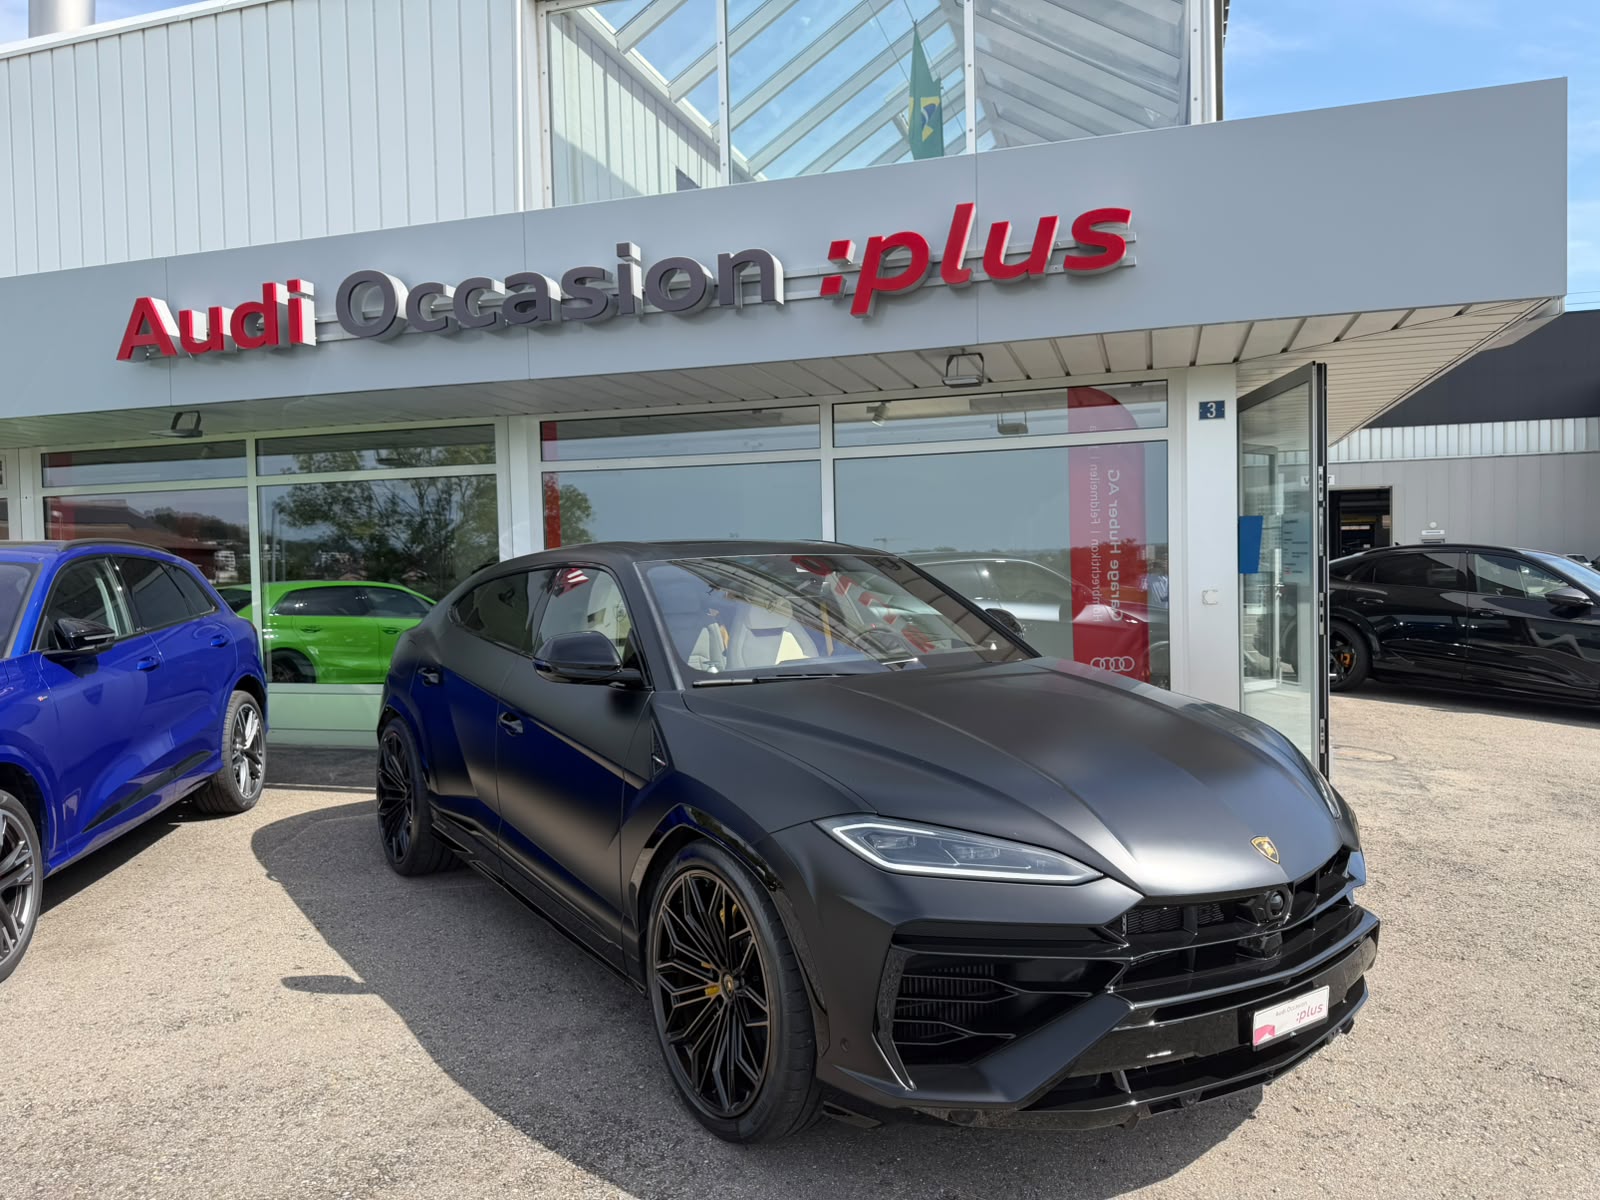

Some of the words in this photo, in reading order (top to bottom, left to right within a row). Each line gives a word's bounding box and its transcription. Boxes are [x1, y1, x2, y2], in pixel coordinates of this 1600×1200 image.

[115, 278, 316, 363] Audi
[335, 241, 784, 341] Occasion
[1207, 402, 1216, 418] 3
